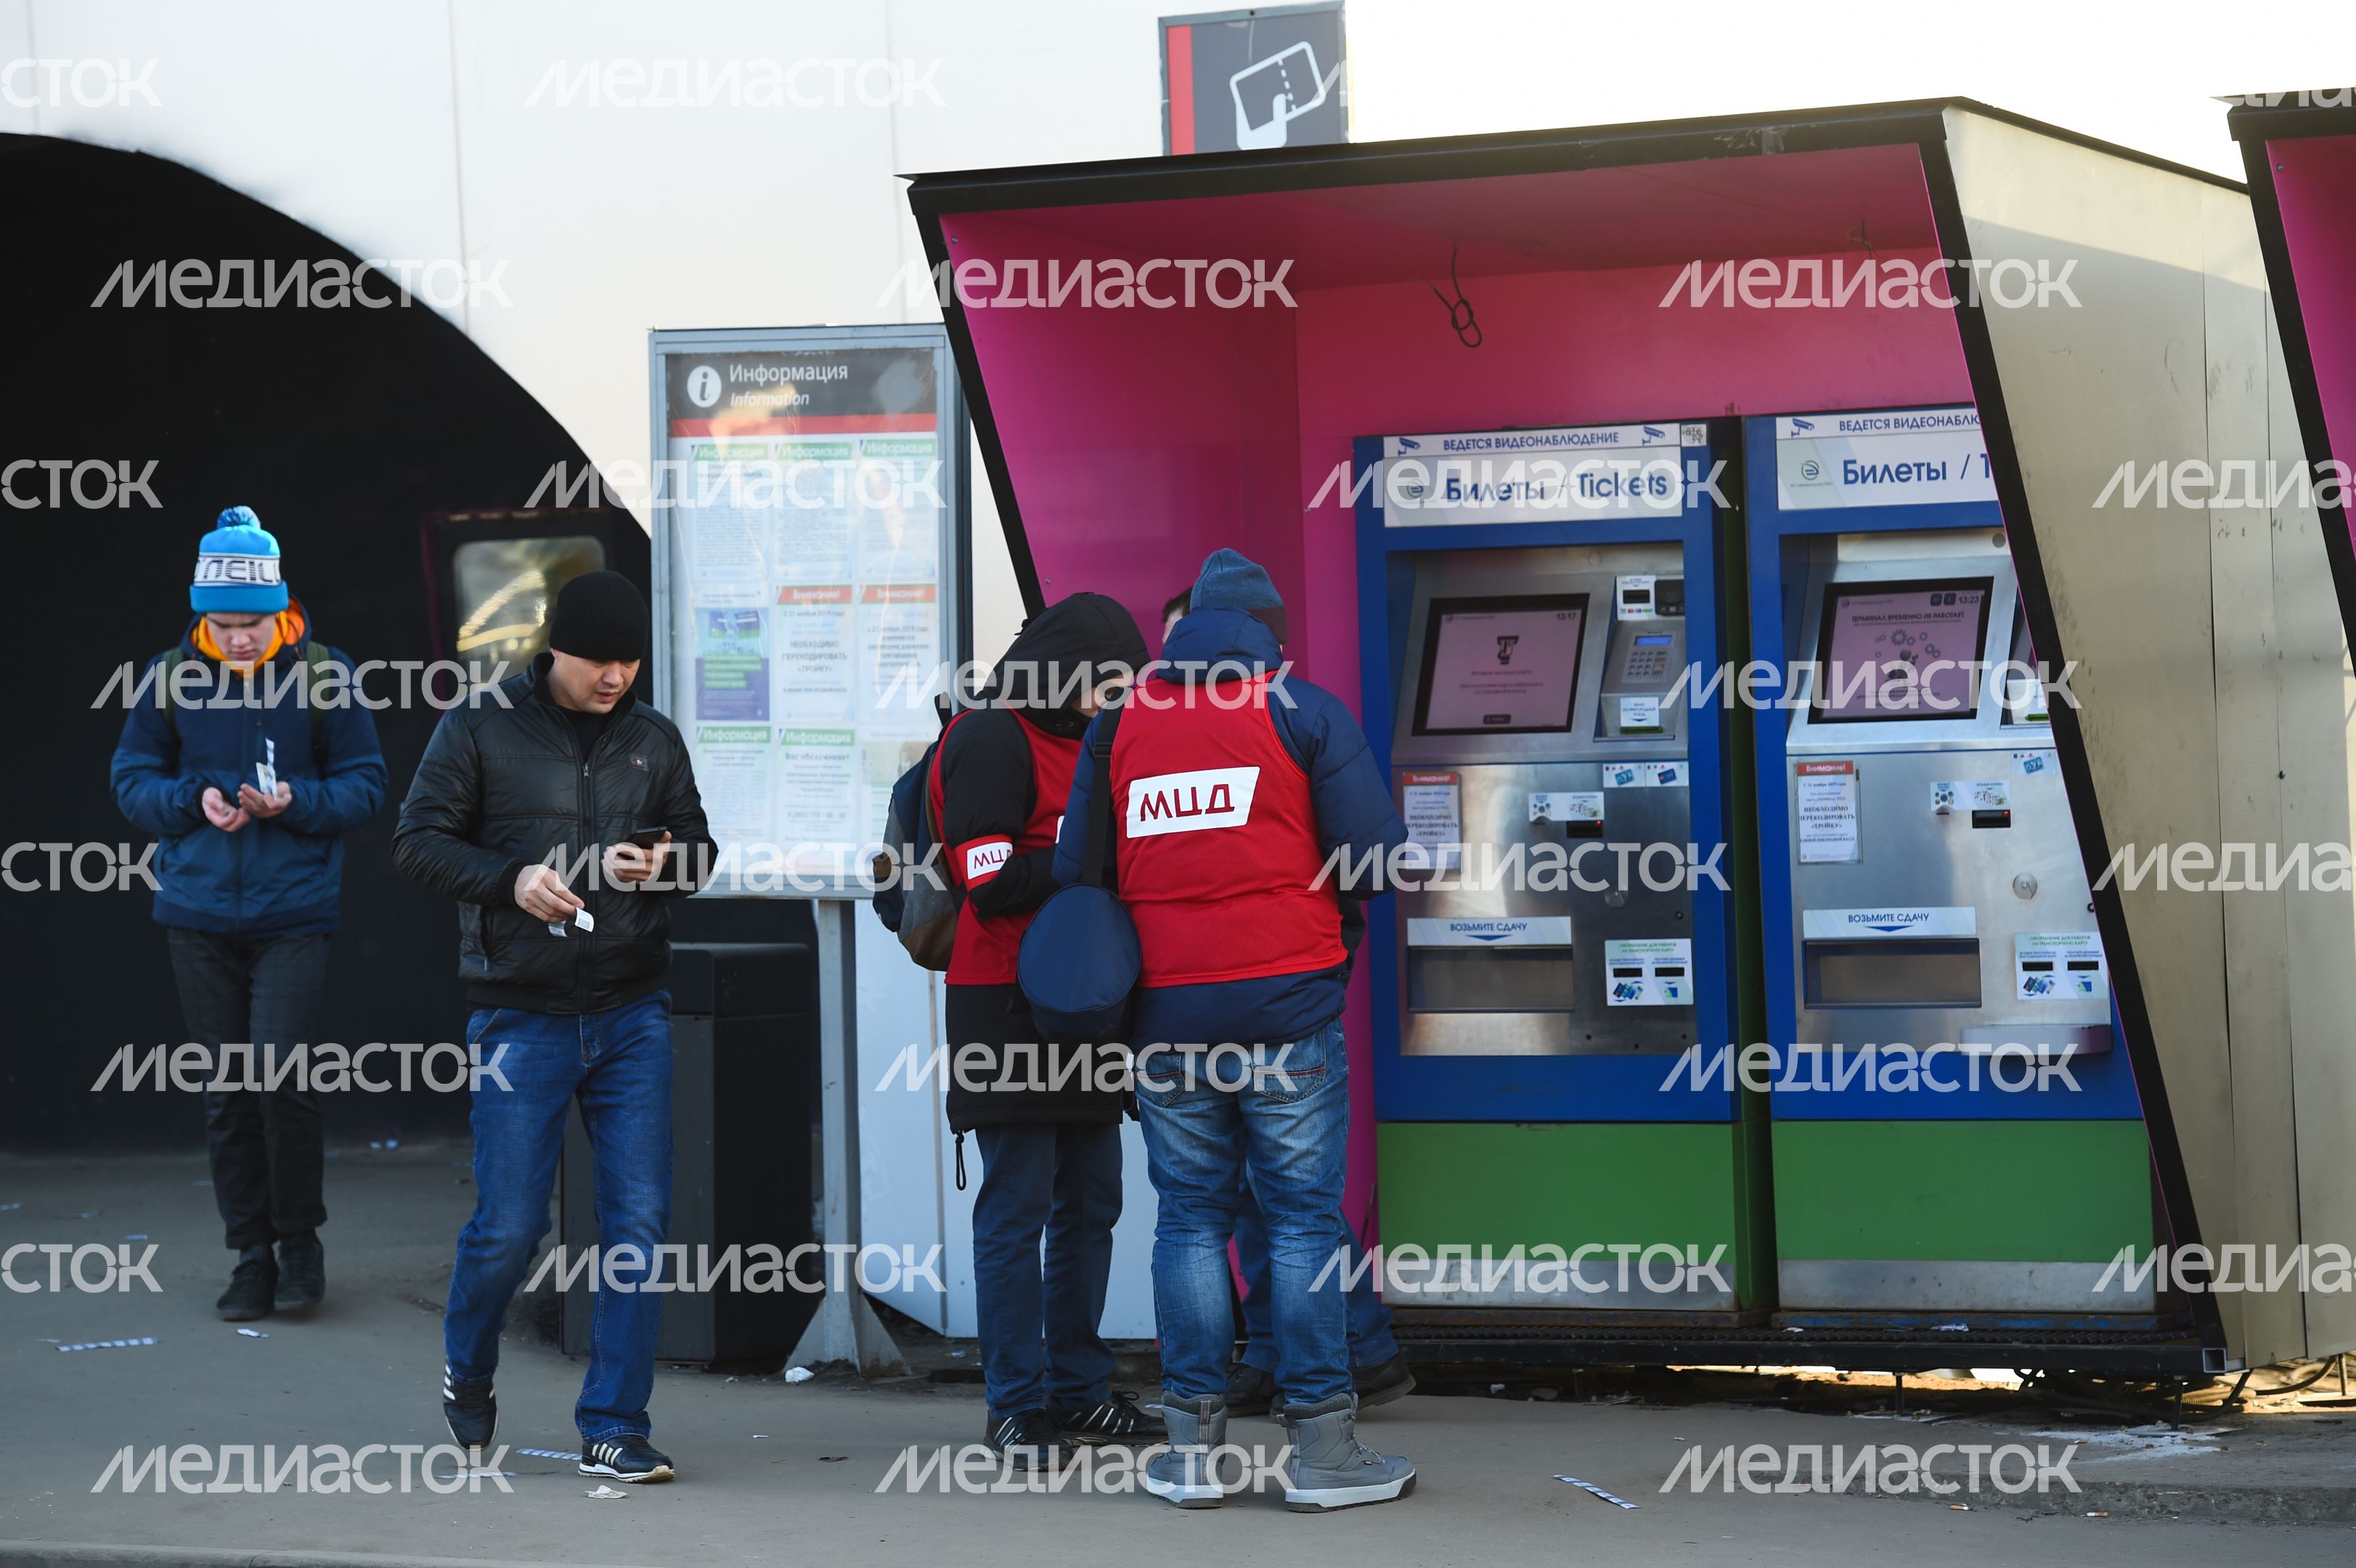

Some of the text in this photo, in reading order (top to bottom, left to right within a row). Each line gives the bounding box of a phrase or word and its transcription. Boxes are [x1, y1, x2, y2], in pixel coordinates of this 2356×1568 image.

[729, 363, 848, 386] Информация
[730, 392, 810, 407] Information
[1840, 419, 1890, 432] ВЕДЕТСЯ
[867, 441, 933, 455] Информация
[1443, 432, 1619, 452] ВЕДЕТСЯ ВИДЕОНАБЛЮДЕНИЕ
[1843, 460, 1947, 485] Билеты
[1446, 477, 1544, 502] Билеты
[1576, 470, 1668, 498] Tickets
[1888, 613, 1923, 621] ВРЕМЕННО
[1140, 783, 1235, 822] МЦД
[1848, 912, 1929, 923] ВОЗЬМИТЕ СДАЧУ
[1451, 922, 1528, 932] ВОЗЬМИТЕ СДАЧУ
